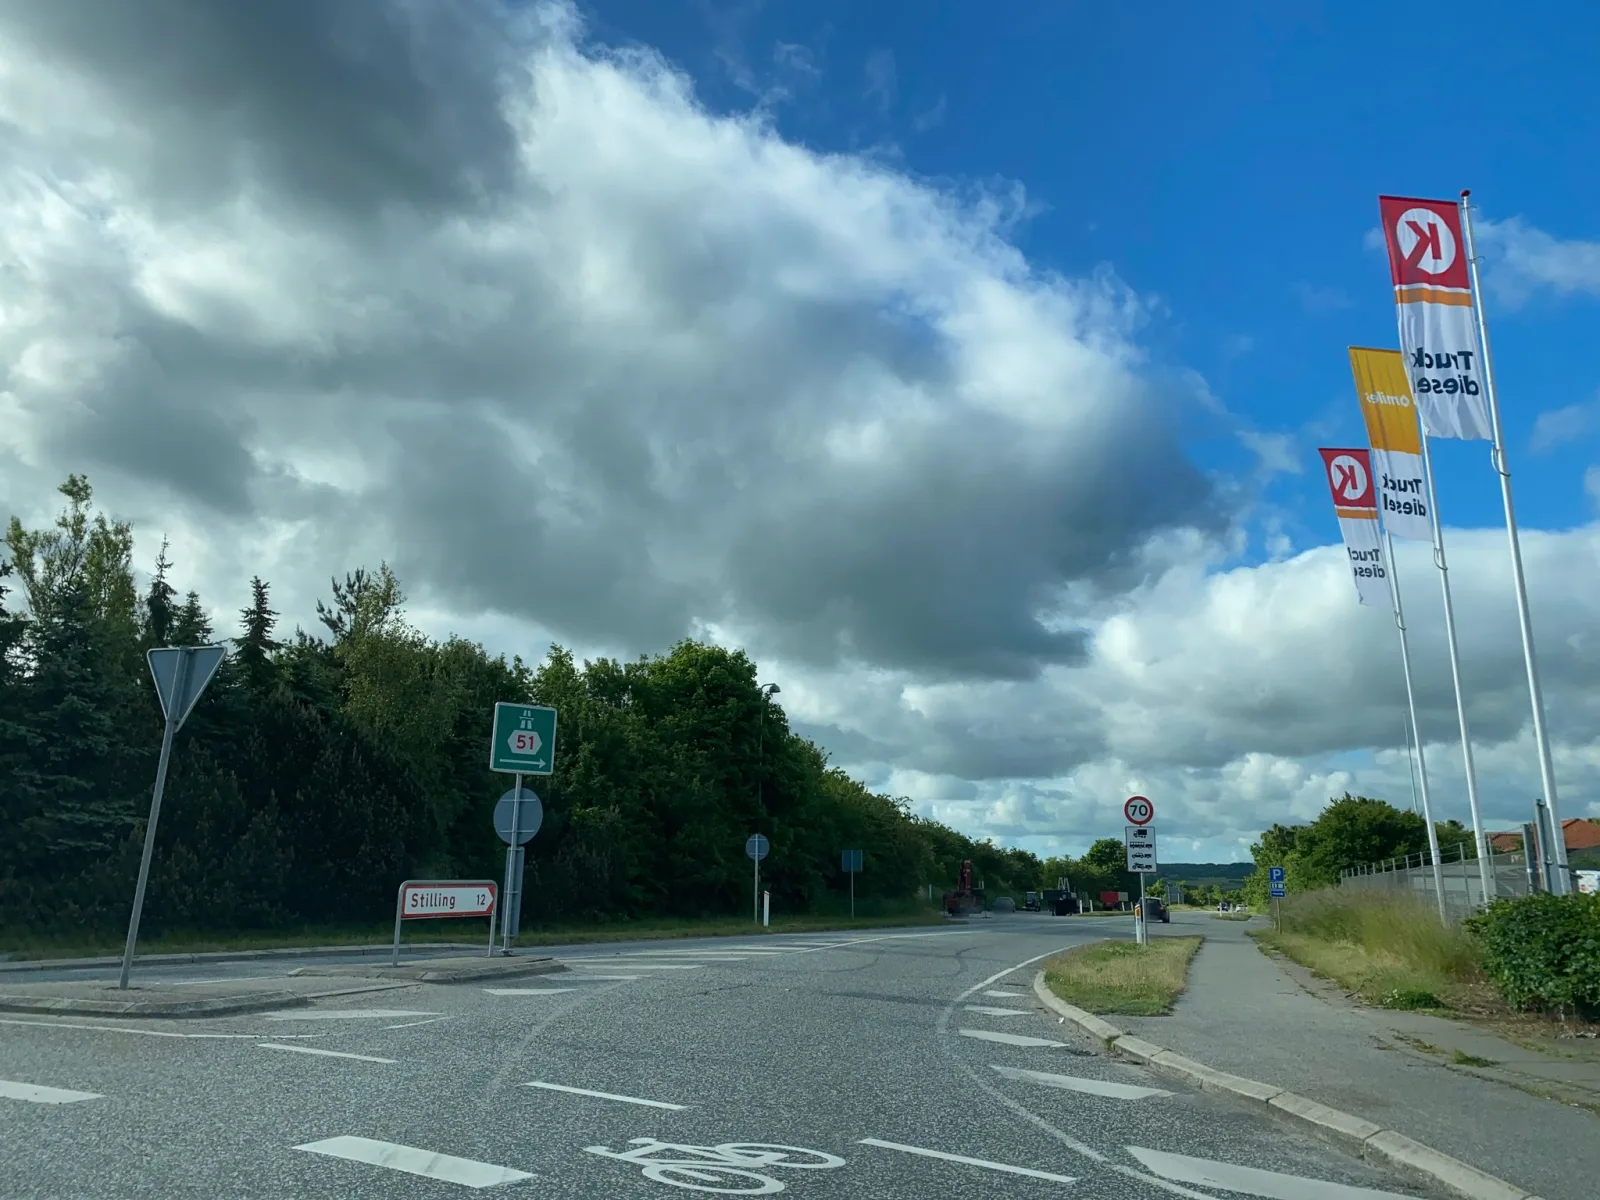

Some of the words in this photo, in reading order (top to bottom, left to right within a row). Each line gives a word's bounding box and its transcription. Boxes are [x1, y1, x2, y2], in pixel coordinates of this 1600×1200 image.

[516, 734, 534, 750] 51
[1130, 804, 1148, 816] 70
[1273, 869, 1281, 880] P
[411, 893, 456, 909] Stilling
[476, 894, 486, 906] 12
